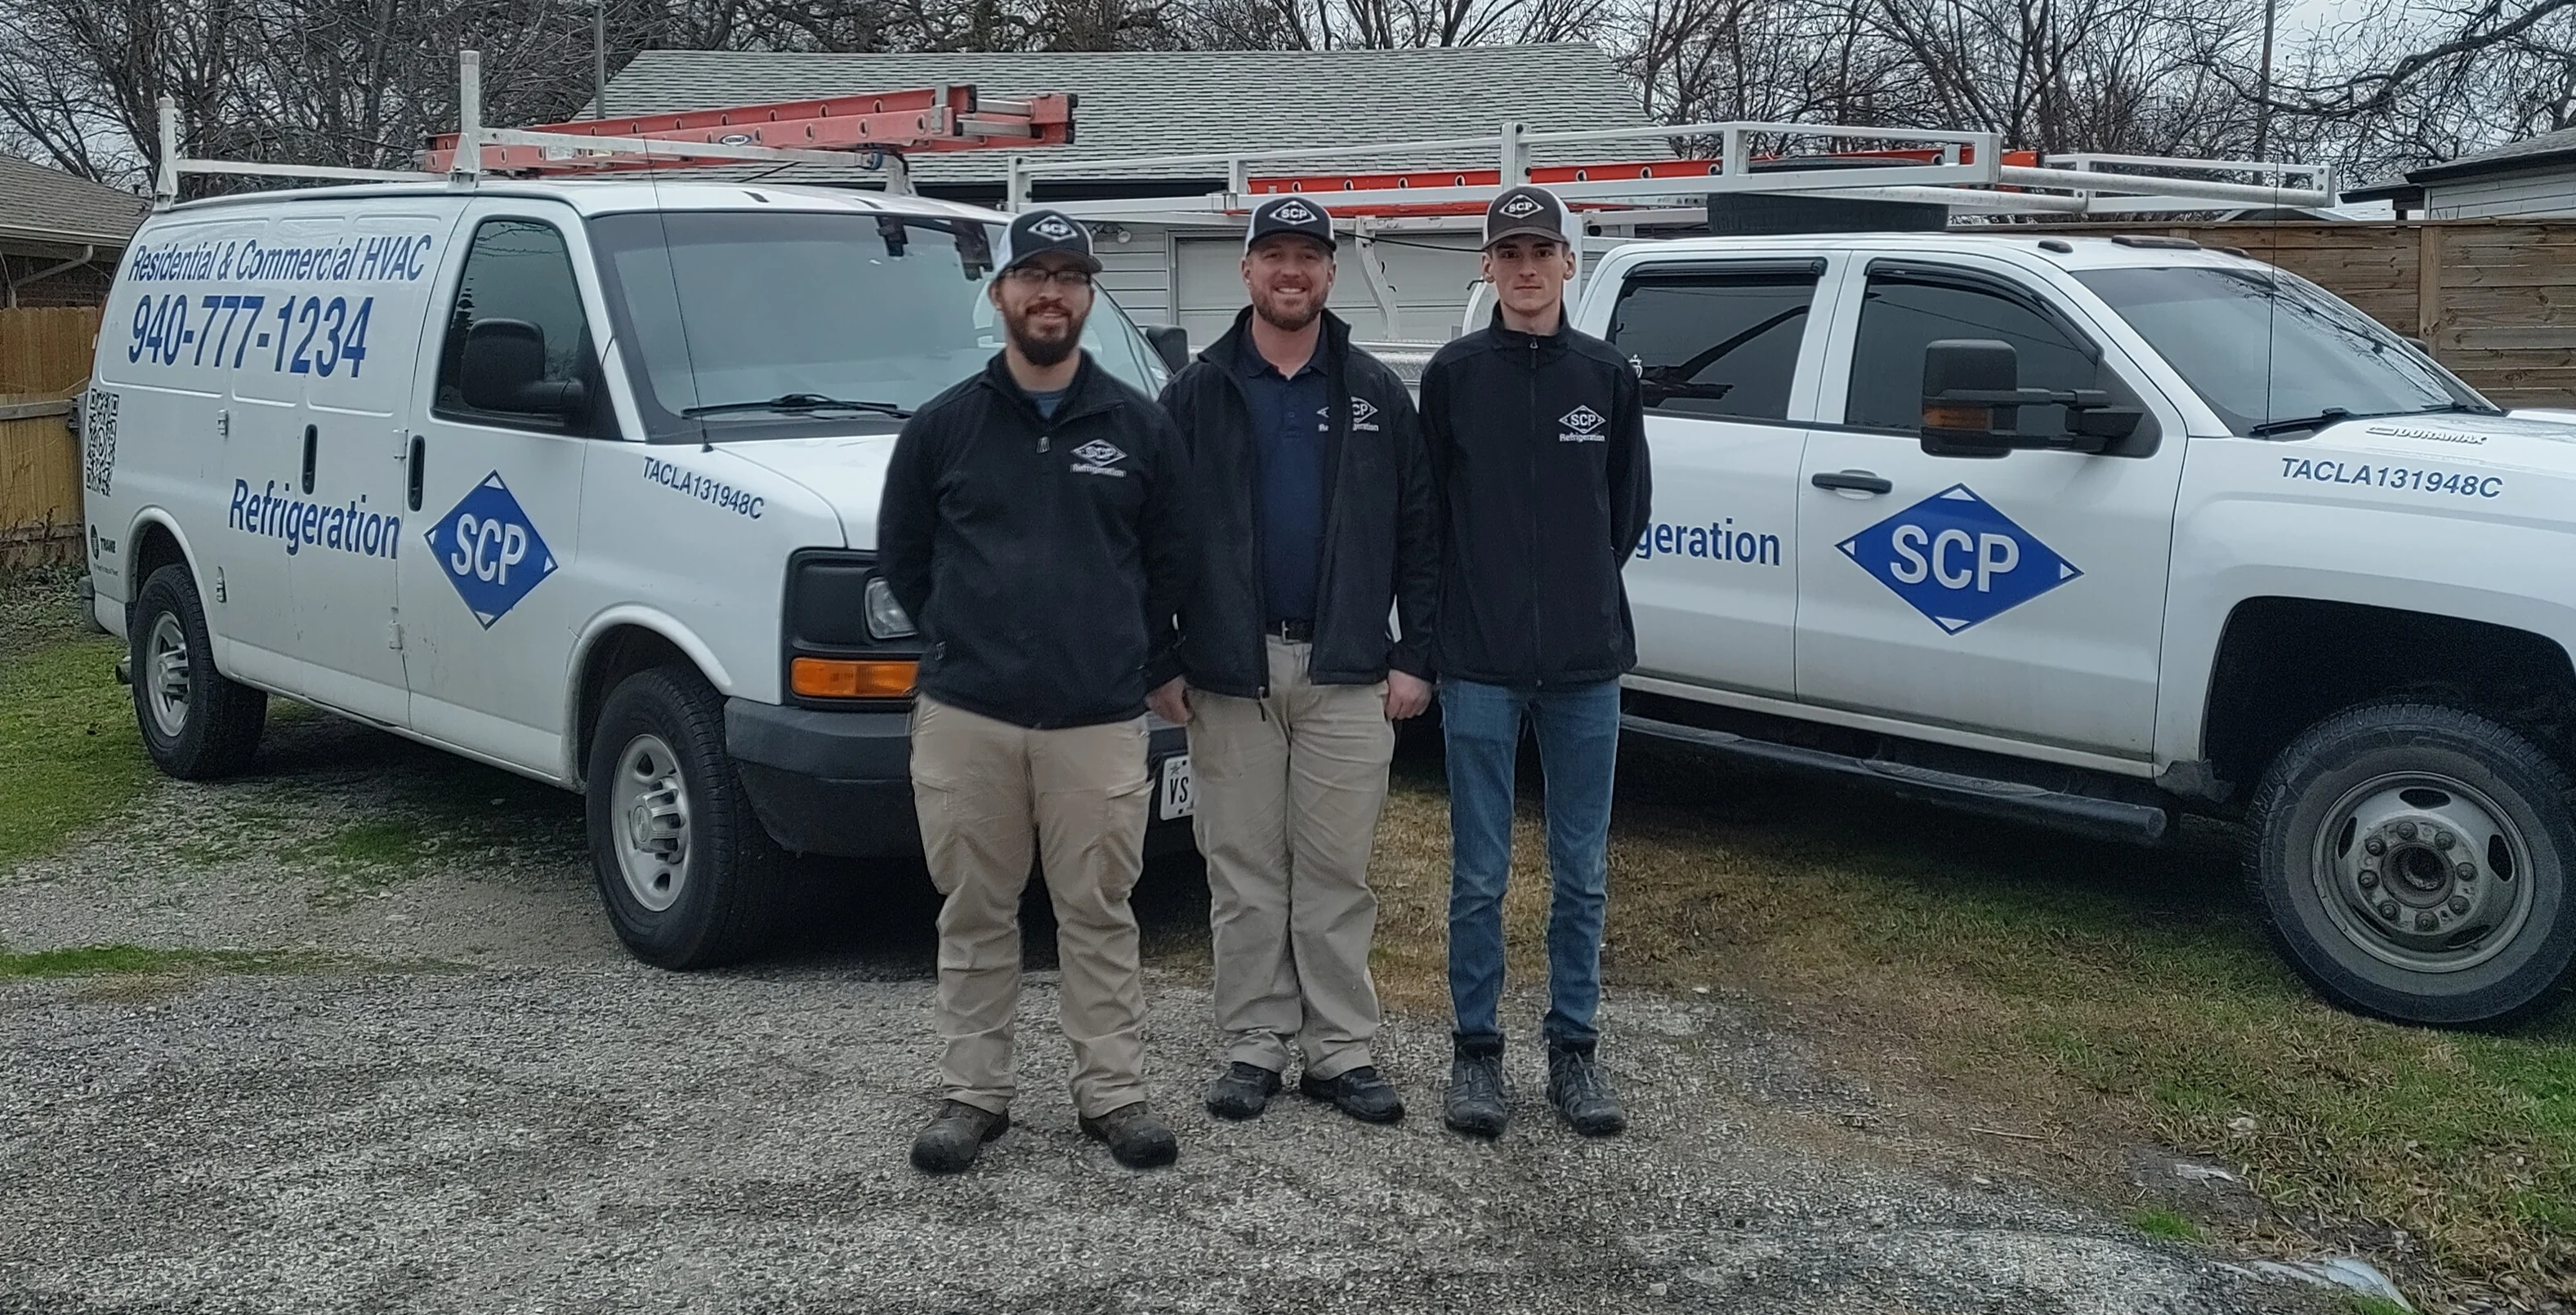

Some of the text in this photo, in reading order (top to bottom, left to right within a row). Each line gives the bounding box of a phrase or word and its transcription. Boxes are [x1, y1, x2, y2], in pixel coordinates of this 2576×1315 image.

[1280, 207, 1307, 219] SCP
[1509, 201, 1533, 213] SCP
[127, 234, 432, 281] Residential & Commercial HVAC
[128, 293, 374, 377] 940-777-1234
[1570, 413, 1596, 426] SCP
[2394, 427, 2488, 444] DURAMAX
[642, 456, 765, 520] TACLA131948C
[2281, 457, 2503, 498] TACLA131948C
[229, 478, 401, 560] Refrigeration
[1634, 517, 1780, 567] geration
[451, 513, 527, 586] SCP
[1889, 524, 2020, 593] SCP
